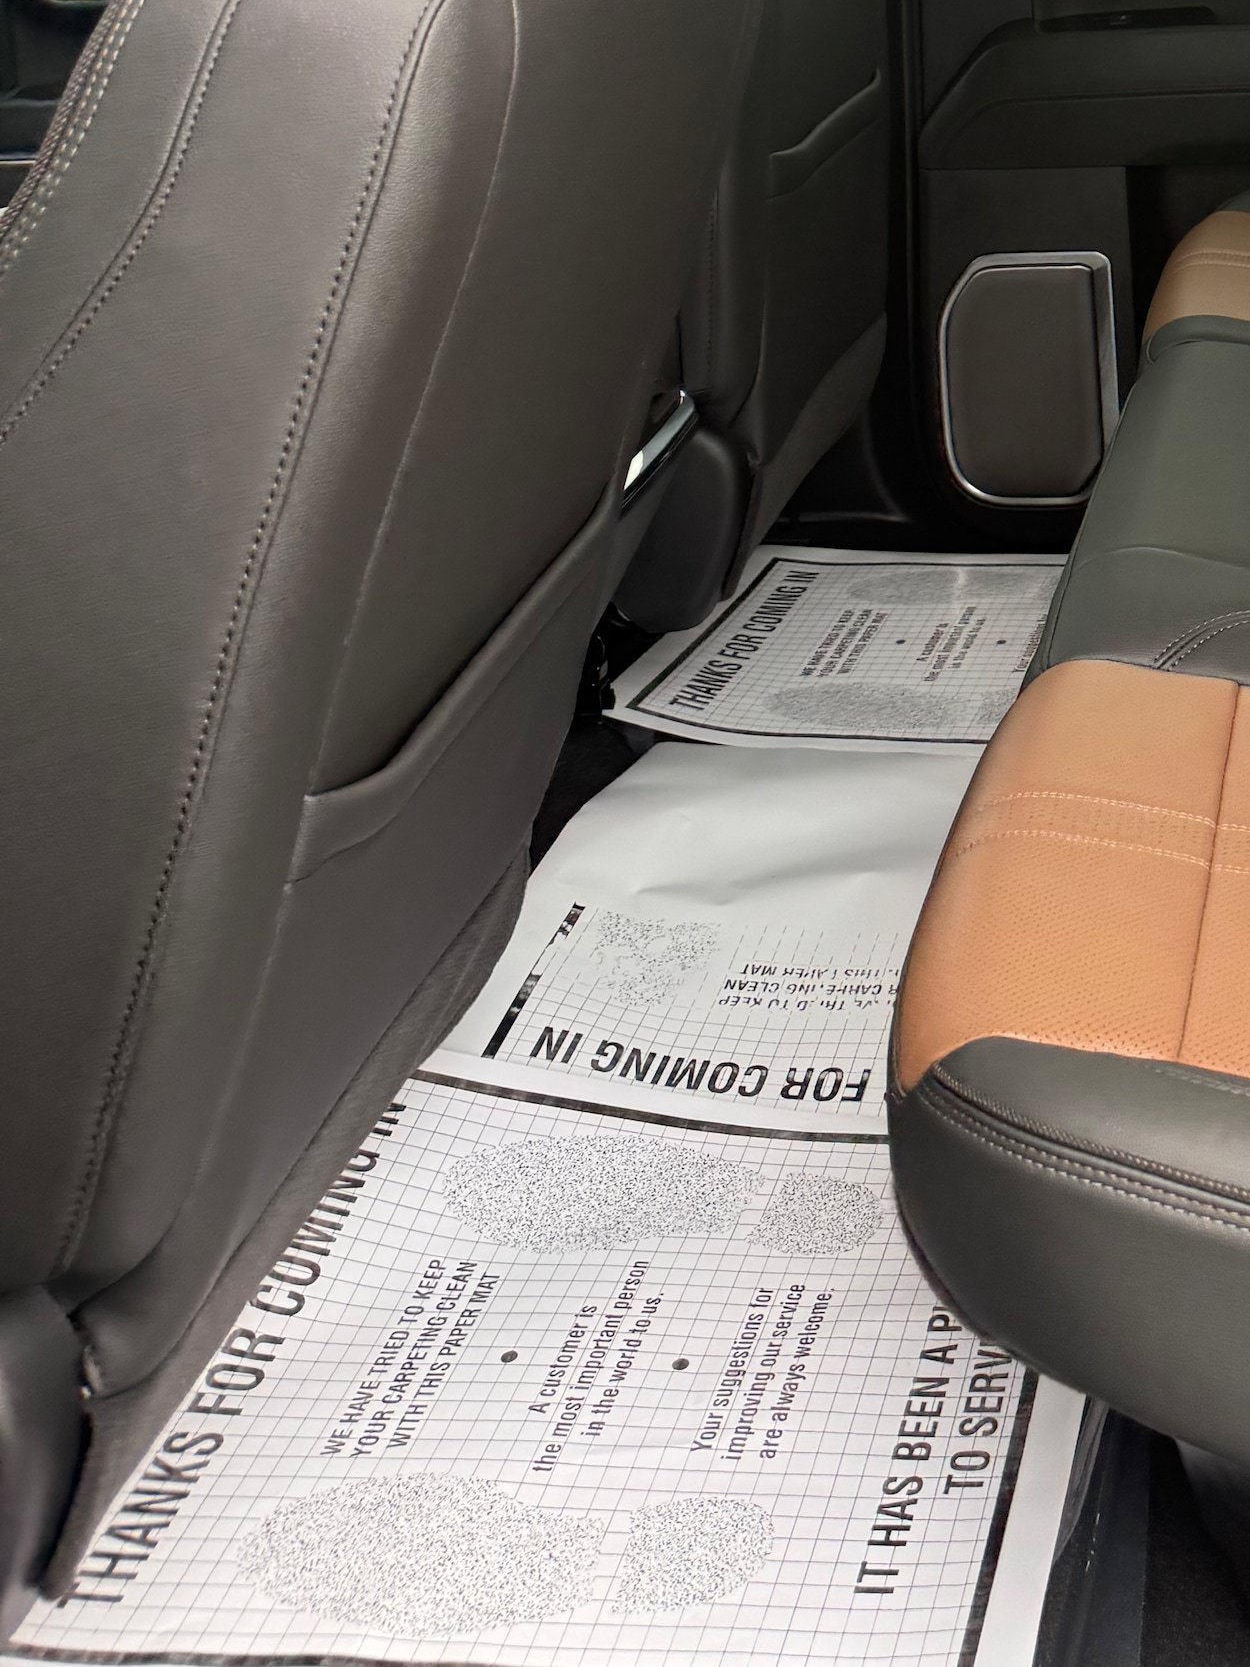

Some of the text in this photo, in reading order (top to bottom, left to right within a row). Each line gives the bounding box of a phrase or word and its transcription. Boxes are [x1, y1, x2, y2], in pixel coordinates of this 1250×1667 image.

[668, 570, 820, 711] THANKS FOR COMING IN
[724, 978, 780, 995] CLEAN
[740, 963, 776, 976] MAT
[528, 1025, 872, 1103] FOR COMING IN
[320, 1259, 447, 1456] WE HAVE TRIED TO KEEP
[351, 1261, 478, 1458] YOUR CARPETING CLEAN
[386, 1271, 500, 1449] WITH THIS PAPER MAT
[528, 1305, 598, 1415] A customer is
[532, 1260, 650, 1472] the most important person
[581, 1292, 665, 1436] in the world to us.
[691, 1287, 775, 1452] Your suggestions for
[721, 1284, 806, 1460] improving our service
[770, 1363, 807, 1422] always
[920, 1343, 958, 1365] A
[759, 1427, 783, 1459] are
[891, 1377, 950, 1461] BEEN
[57, 1430, 225, 1610] THANKS
[183, 1326, 286, 1417] FOR
[867, 1476, 924, 1547] HAS
[943, 1449, 991, 1495] TO
[853, 1561, 900, 1594] IT
